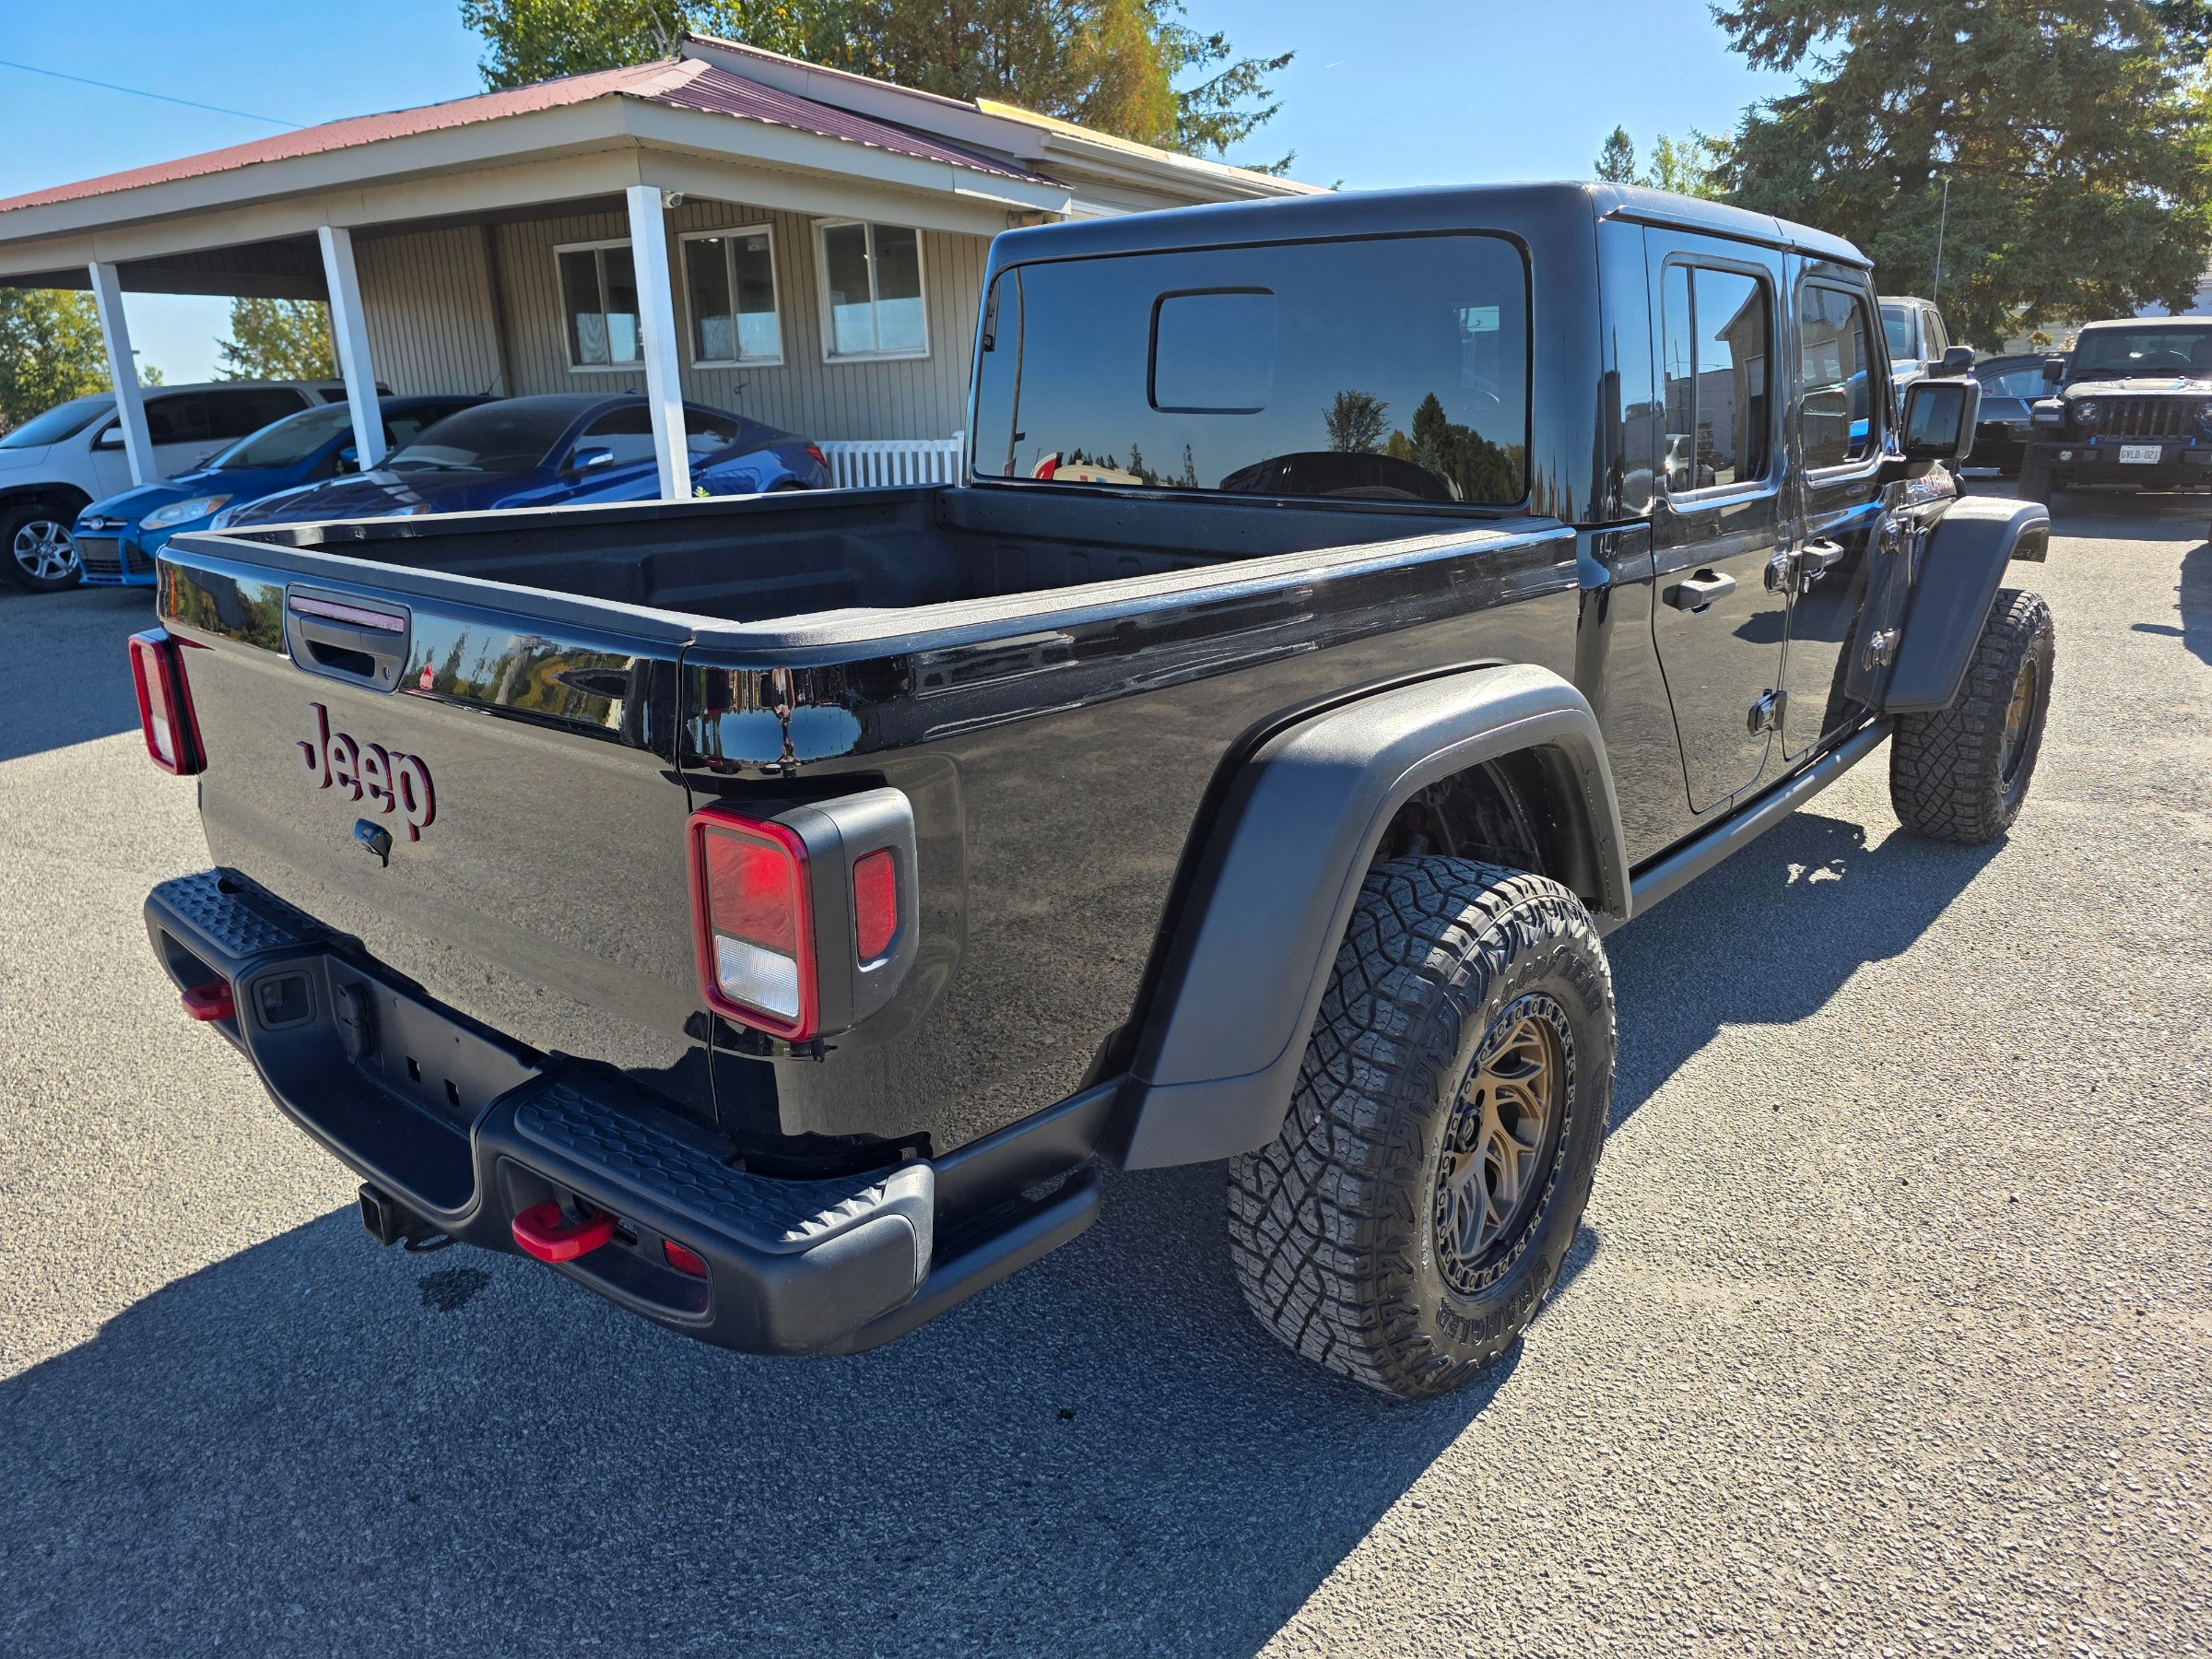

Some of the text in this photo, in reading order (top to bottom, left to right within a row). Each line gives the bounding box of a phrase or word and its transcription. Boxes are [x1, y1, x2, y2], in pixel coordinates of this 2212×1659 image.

[2121, 450, 2159, 459] GVLD 021
[296, 701, 437, 842] Jeep
[1436, 1254, 1551, 1346] WRANGLER
